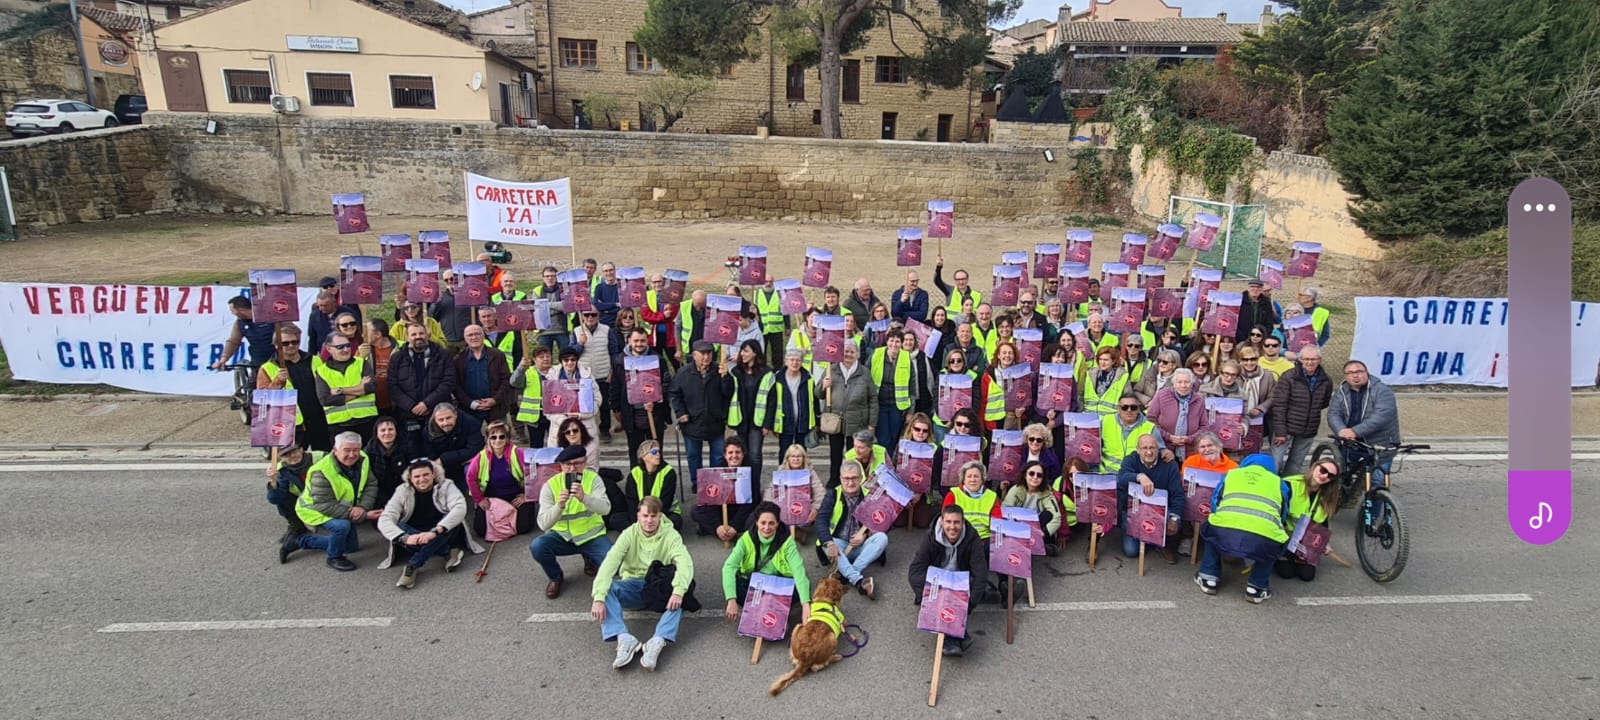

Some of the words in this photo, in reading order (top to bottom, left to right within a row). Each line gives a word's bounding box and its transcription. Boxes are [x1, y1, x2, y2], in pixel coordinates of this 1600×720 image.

[475, 184, 558, 206] CARRETERA
[23, 285, 214, 315] VERGÜENZA
[1380, 350, 1465, 377] DIGNA
